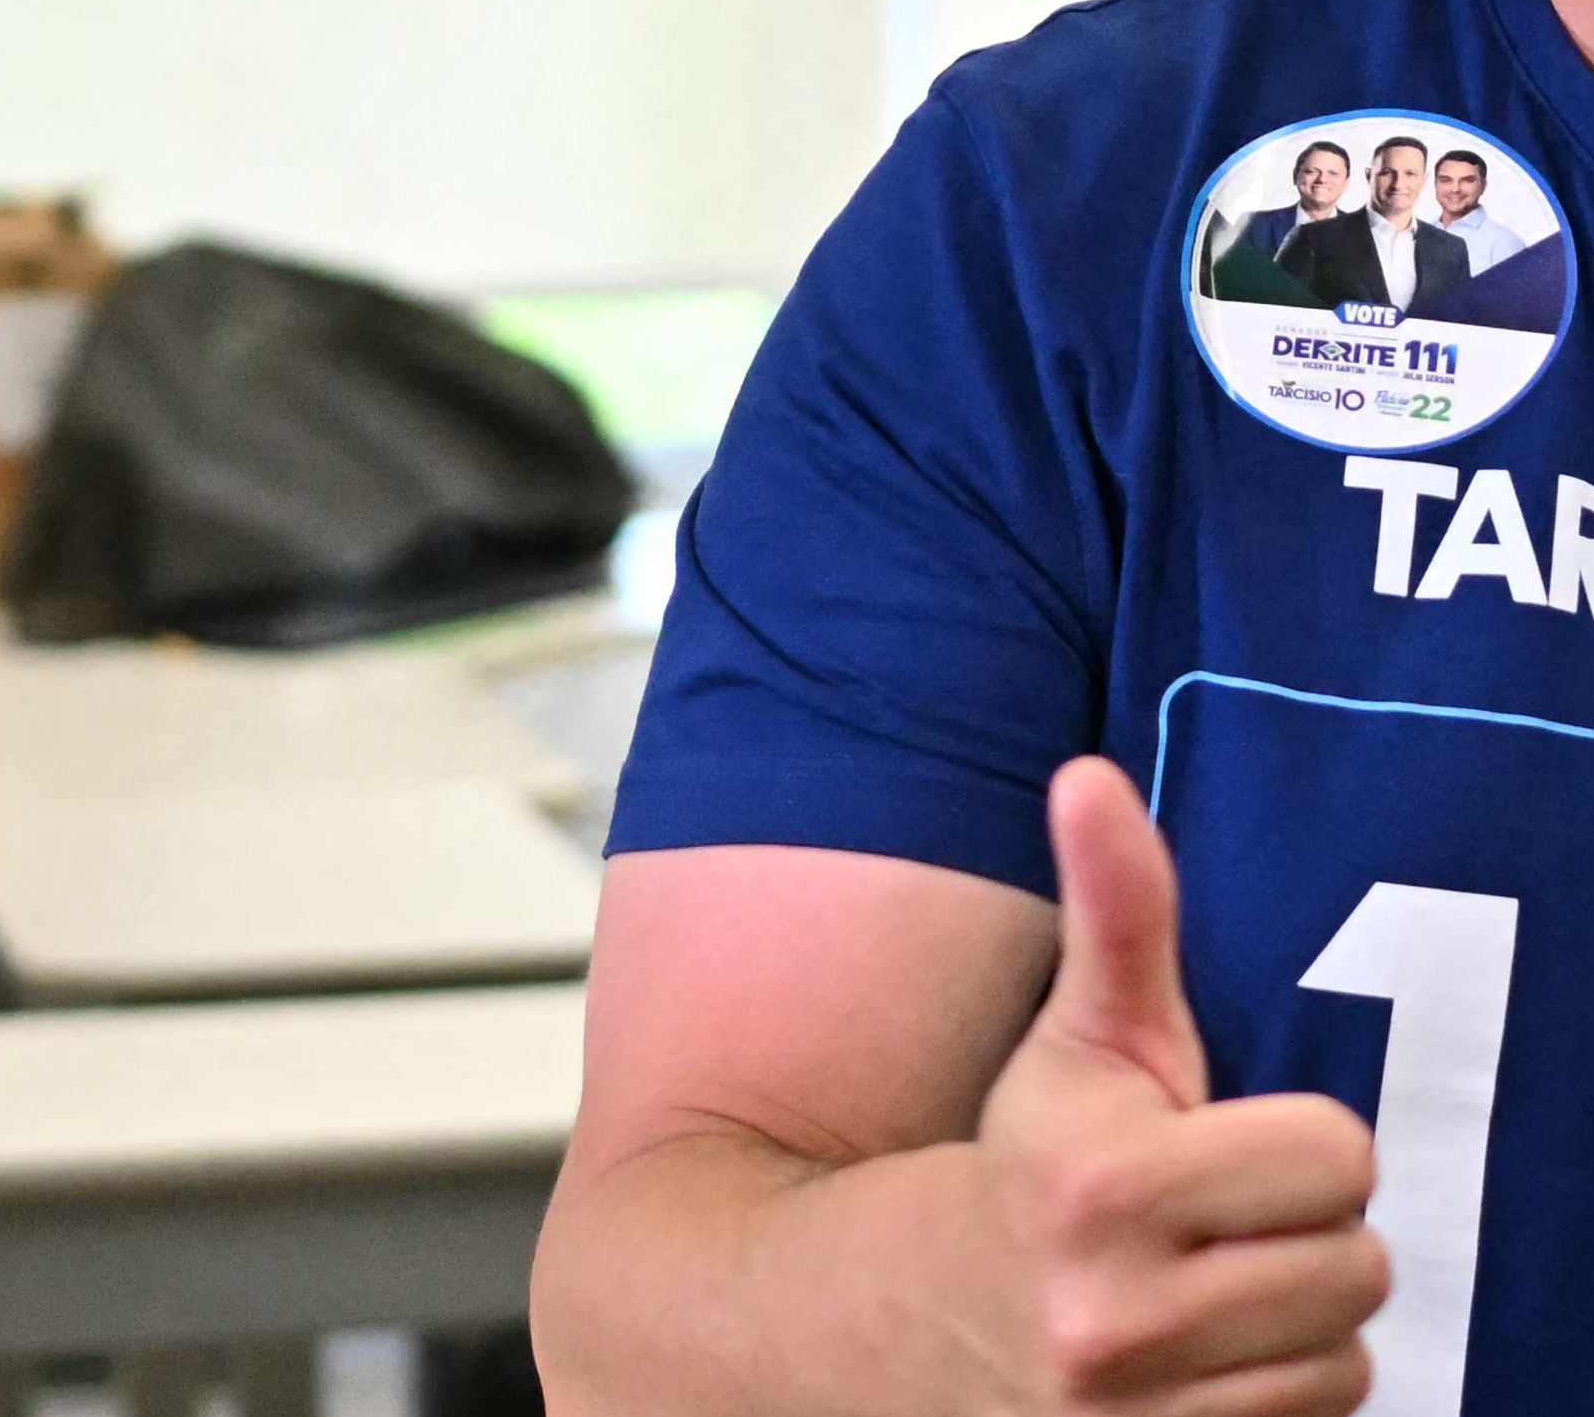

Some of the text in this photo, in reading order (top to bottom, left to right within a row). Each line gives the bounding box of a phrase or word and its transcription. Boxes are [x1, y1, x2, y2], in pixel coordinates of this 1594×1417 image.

[1344, 303, 1397, 326] VOTE
[1272, 335, 1460, 374] DERRITE 111
[1335, 388, 1365, 411] 10
[1408, 394, 1452, 422] 22
